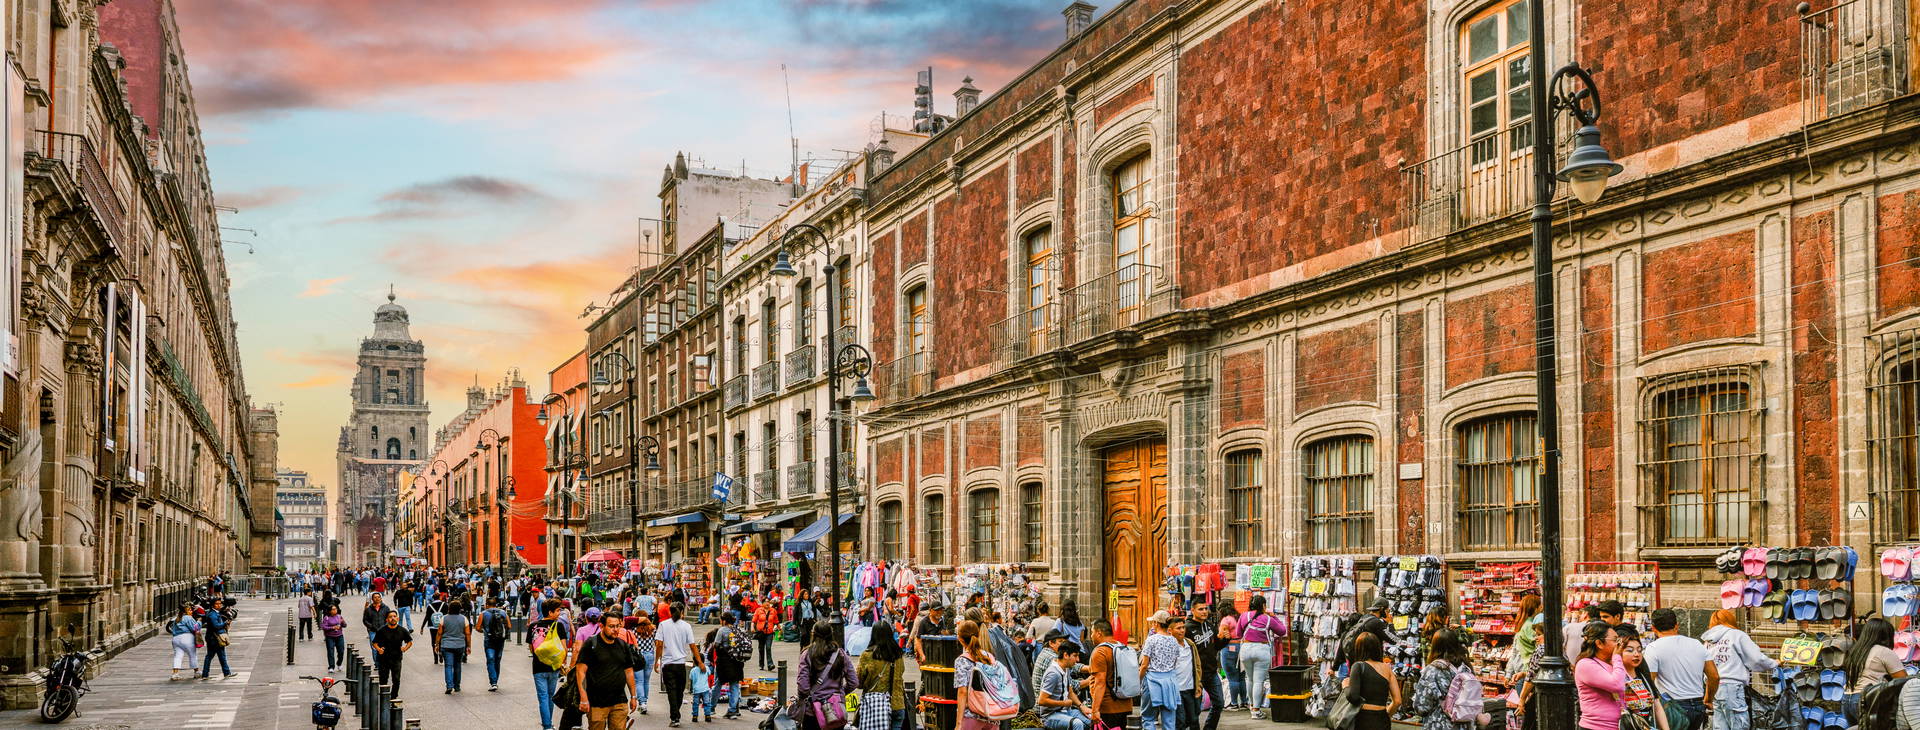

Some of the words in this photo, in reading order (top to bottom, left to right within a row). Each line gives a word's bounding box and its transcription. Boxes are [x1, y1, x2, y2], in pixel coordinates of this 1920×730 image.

[716, 472, 731, 489] WC
[1853, 505, 1866, 517] A
[1783, 645, 1816, 663] 50
